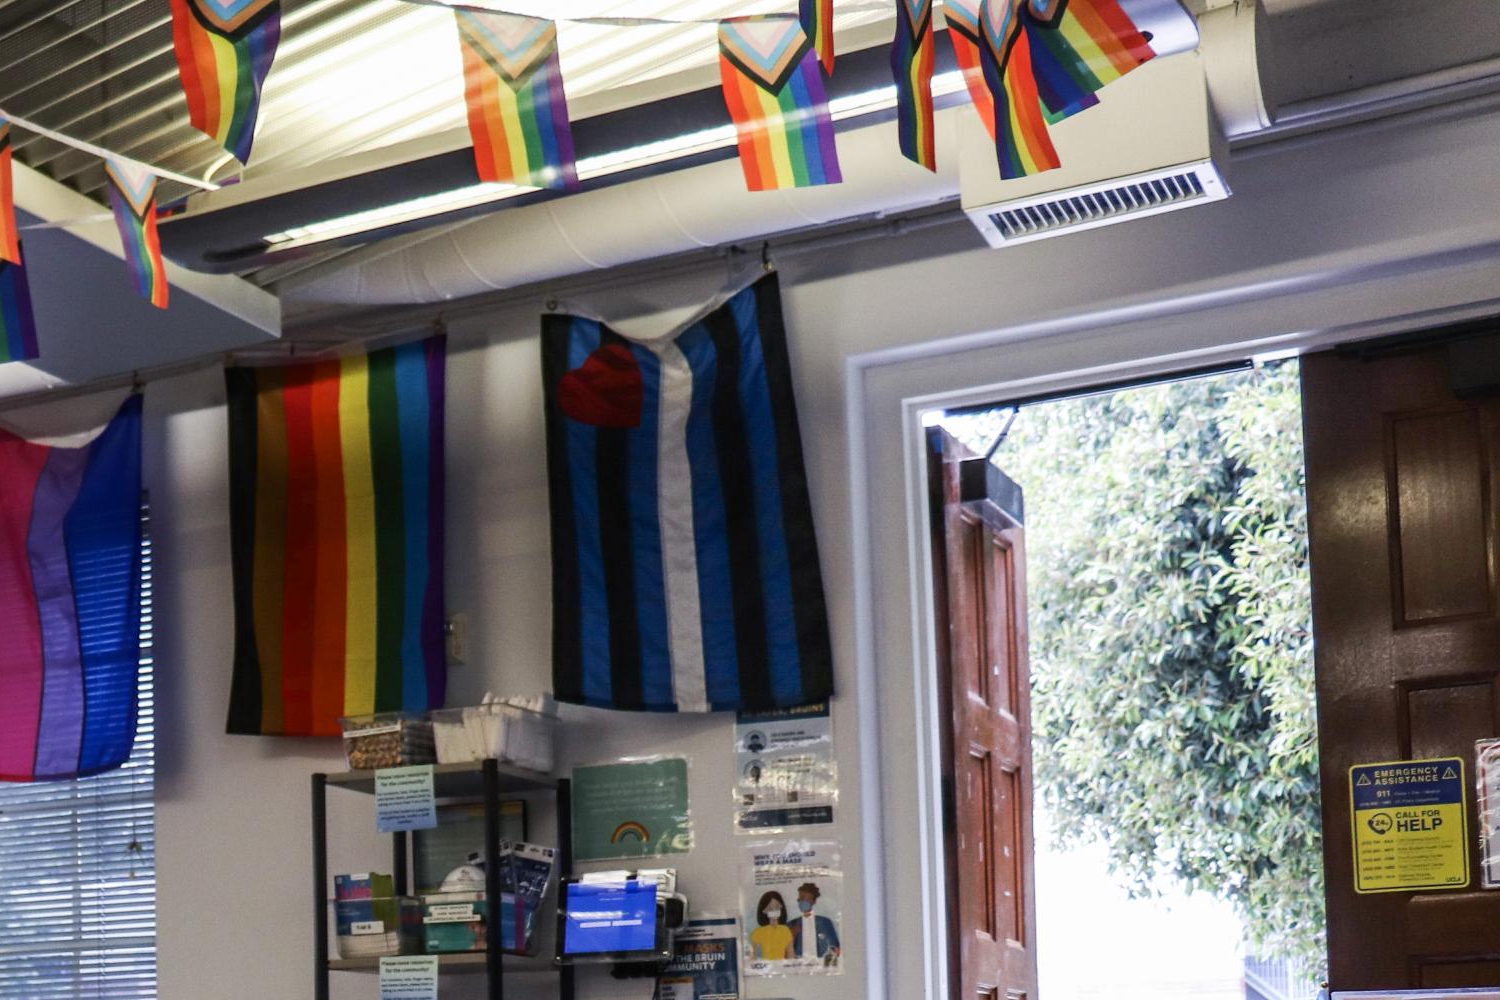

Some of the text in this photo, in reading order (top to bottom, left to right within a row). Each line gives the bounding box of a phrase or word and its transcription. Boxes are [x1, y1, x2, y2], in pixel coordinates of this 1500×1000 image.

[1374, 766, 1438, 778] EMERGENCY
[1374, 774, 1439, 786] ASSISTANCE
[1376, 790, 1391, 798] 911
[1395, 809, 1440, 820] CALL FOR
[1396, 818, 1443, 833] HELP
[694, 952, 726, 962] BRUIN
